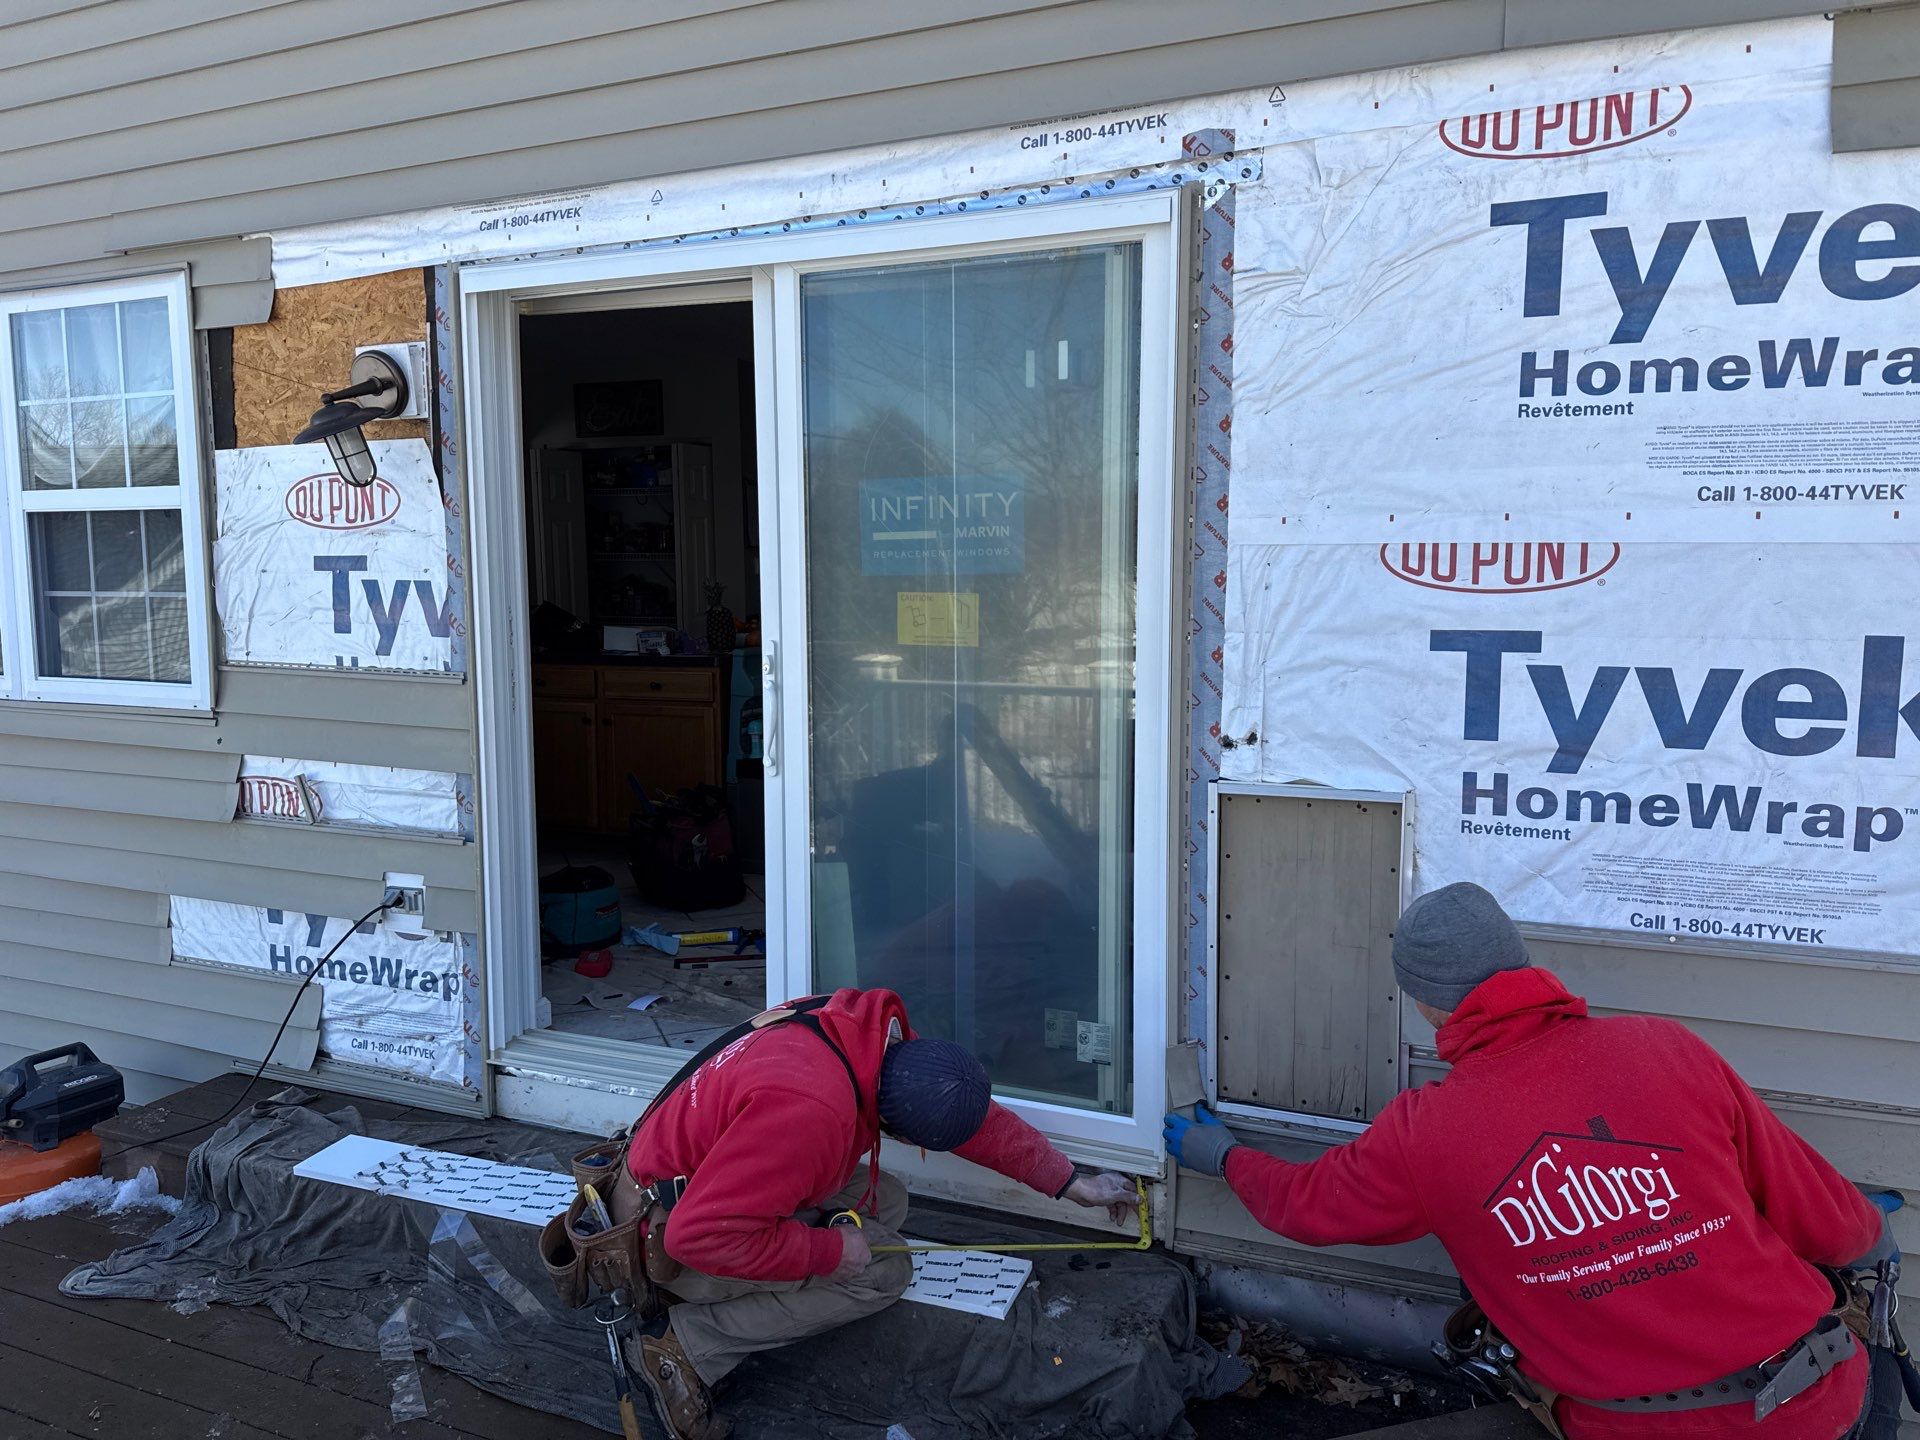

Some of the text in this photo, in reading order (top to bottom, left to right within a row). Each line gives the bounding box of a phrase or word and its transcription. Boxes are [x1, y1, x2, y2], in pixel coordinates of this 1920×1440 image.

[1021, 134, 1048, 150] Call
[1053, 113, 1168, 145] 1-800-44TYVEK
[480, 207, 582, 232] Call 1-800-44TYVEK
[1518, 401, 1634, 418] Revêtement
[871, 491, 1018, 522] INFINITY
[1697, 484, 1906, 502] Call 1-800-44TYVEK
[956, 525, 1010, 538] MARVIN
[957, 548, 1010, 557] WINDOWS
[1461, 771, 1904, 852] HomeWrap
[1461, 820, 1571, 842] Revêtement
[1630, 912, 1824, 944] Call 1-800-44TYVEK
[269, 943, 460, 1001] HomeWrap
[351, 1038, 436, 1060] Call 1-800-44TYVEK
[1531, 1244, 1595, 1268] ROOFING
[1599, 1241, 1609, 1252] &
[1540, 1265, 1571, 1285] Family
[1573, 1259, 1611, 1278] Serving
[1611, 1250, 1635, 1266] Your
[1637, 1238, 1673, 1258] Family
[1674, 1227, 1700, 1246] Since
[1566, 1251, 1699, 1302] 1-800-428-6438
